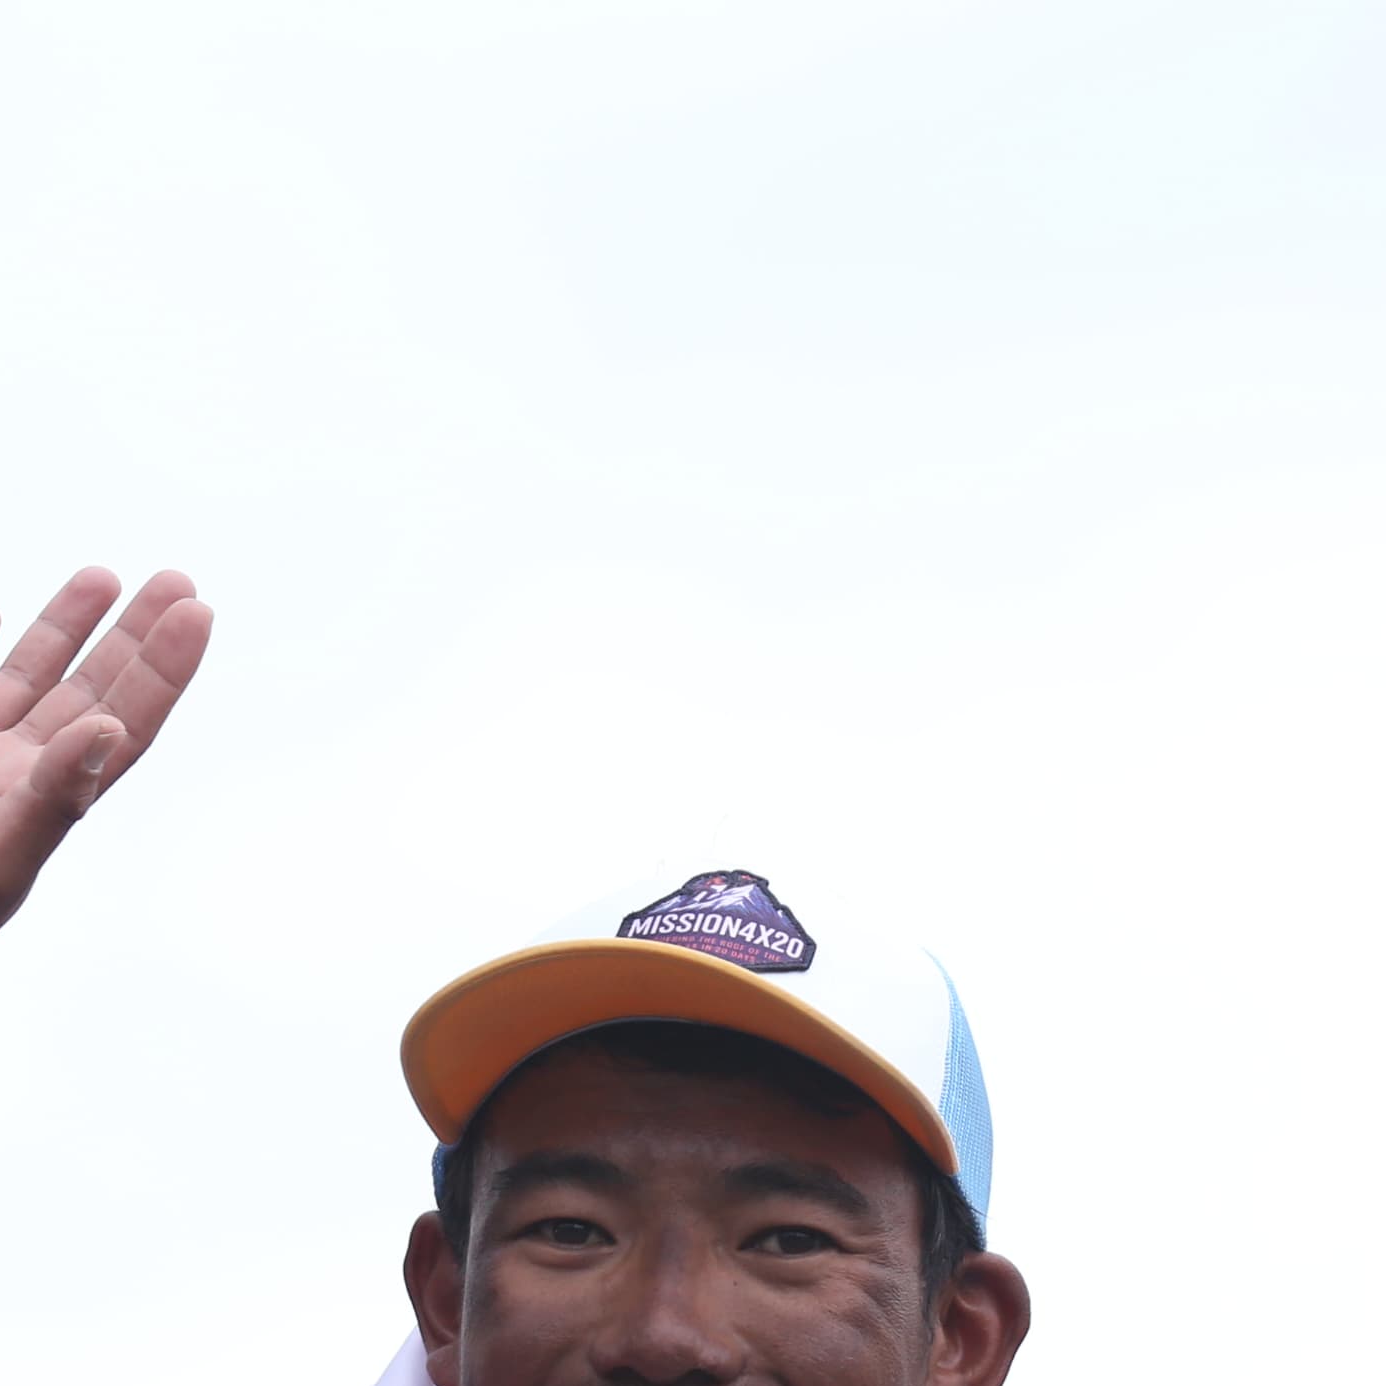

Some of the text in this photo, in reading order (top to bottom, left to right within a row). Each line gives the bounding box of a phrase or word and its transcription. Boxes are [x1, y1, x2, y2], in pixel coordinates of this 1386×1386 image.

[628, 913, 804, 959] MISSION4X20
[698, 936, 716, 945] THE
[748, 947, 760, 956] OF
